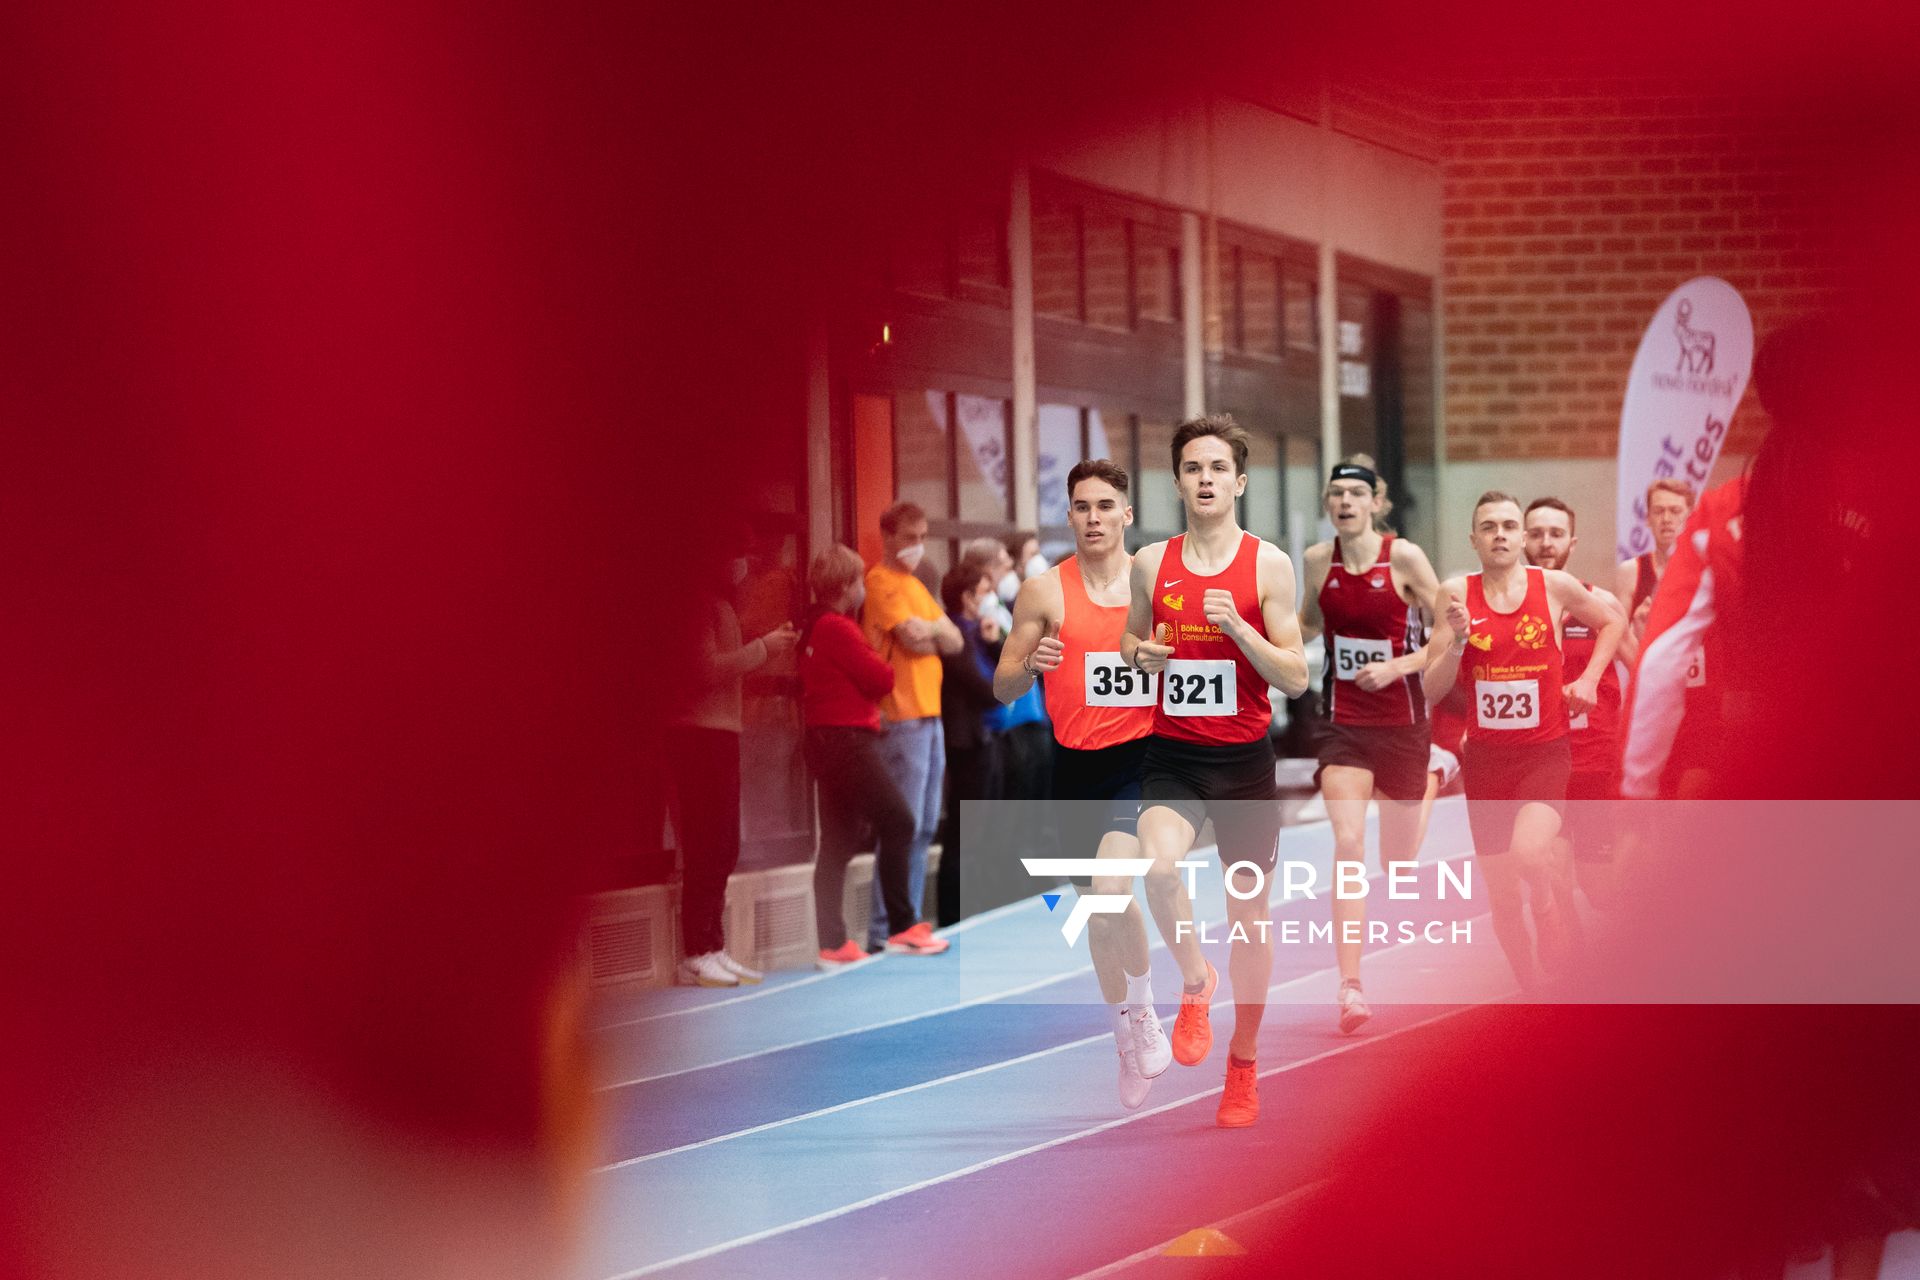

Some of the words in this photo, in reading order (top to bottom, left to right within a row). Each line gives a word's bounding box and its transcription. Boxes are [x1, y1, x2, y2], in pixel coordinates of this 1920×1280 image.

[1181, 632, 1224, 643] Consultants
[1211, 625, 1224, 633] Co
[1340, 649, 1385, 671] 596
[1093, 666, 1150, 696] 351
[1169, 674, 1224, 705] 321
[1482, 692, 1533, 719] 323
